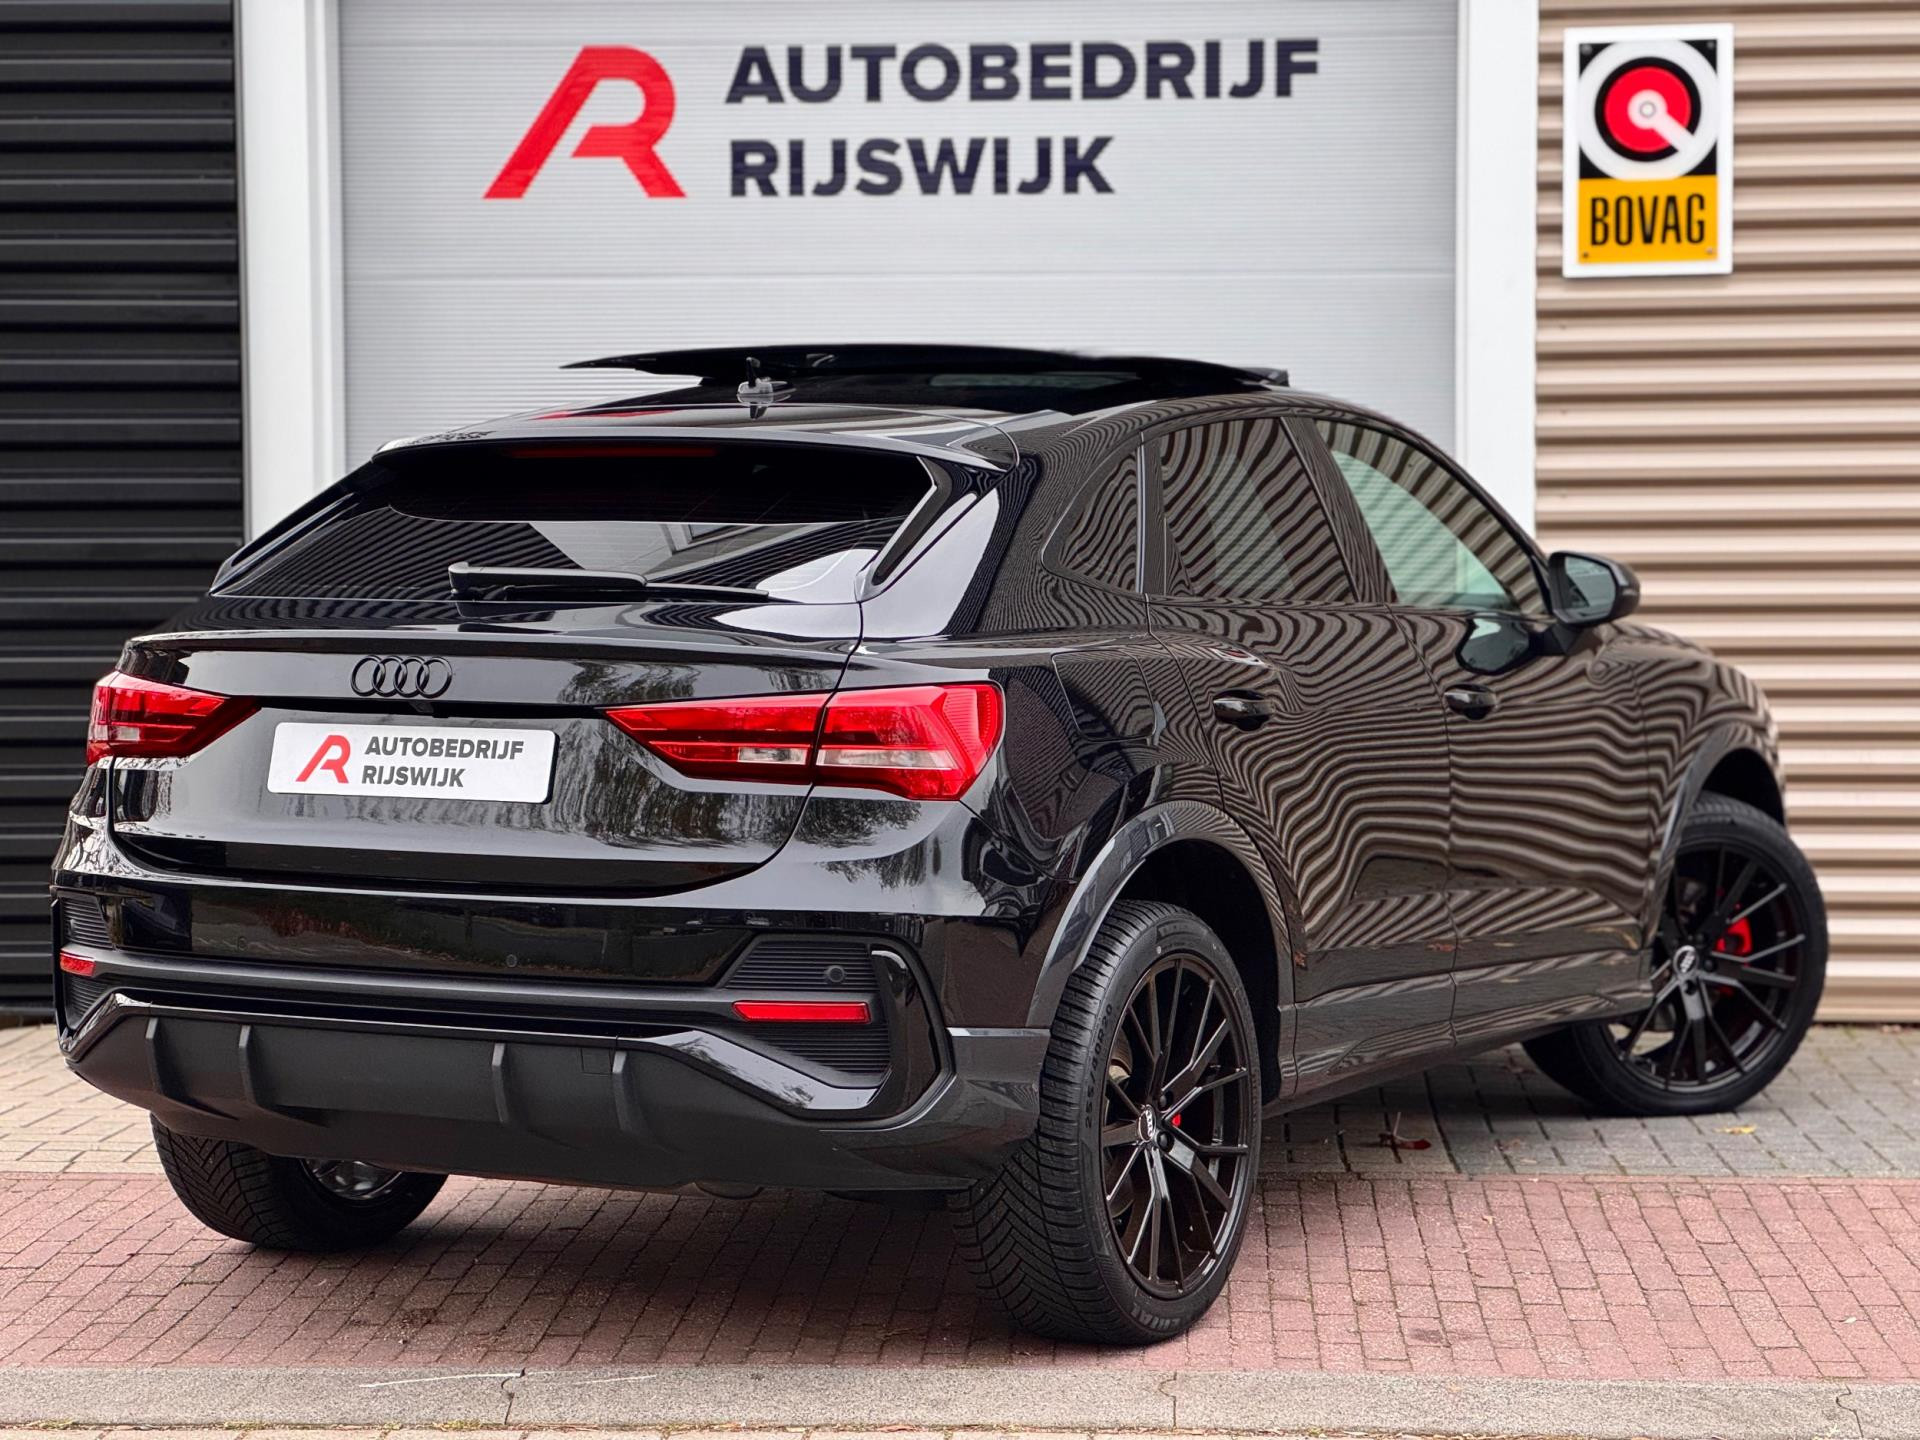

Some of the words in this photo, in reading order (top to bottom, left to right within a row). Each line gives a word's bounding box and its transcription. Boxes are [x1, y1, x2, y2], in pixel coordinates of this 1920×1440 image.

[725, 38, 1319, 104] AUTOBEDRIJF
[729, 136, 1115, 197] RIJSWIJK
[1590, 193, 1706, 247] BOVAG
[364, 735, 524, 760] AUTOBEDRIJF
[361, 765, 466, 788] RIJSWIJK
